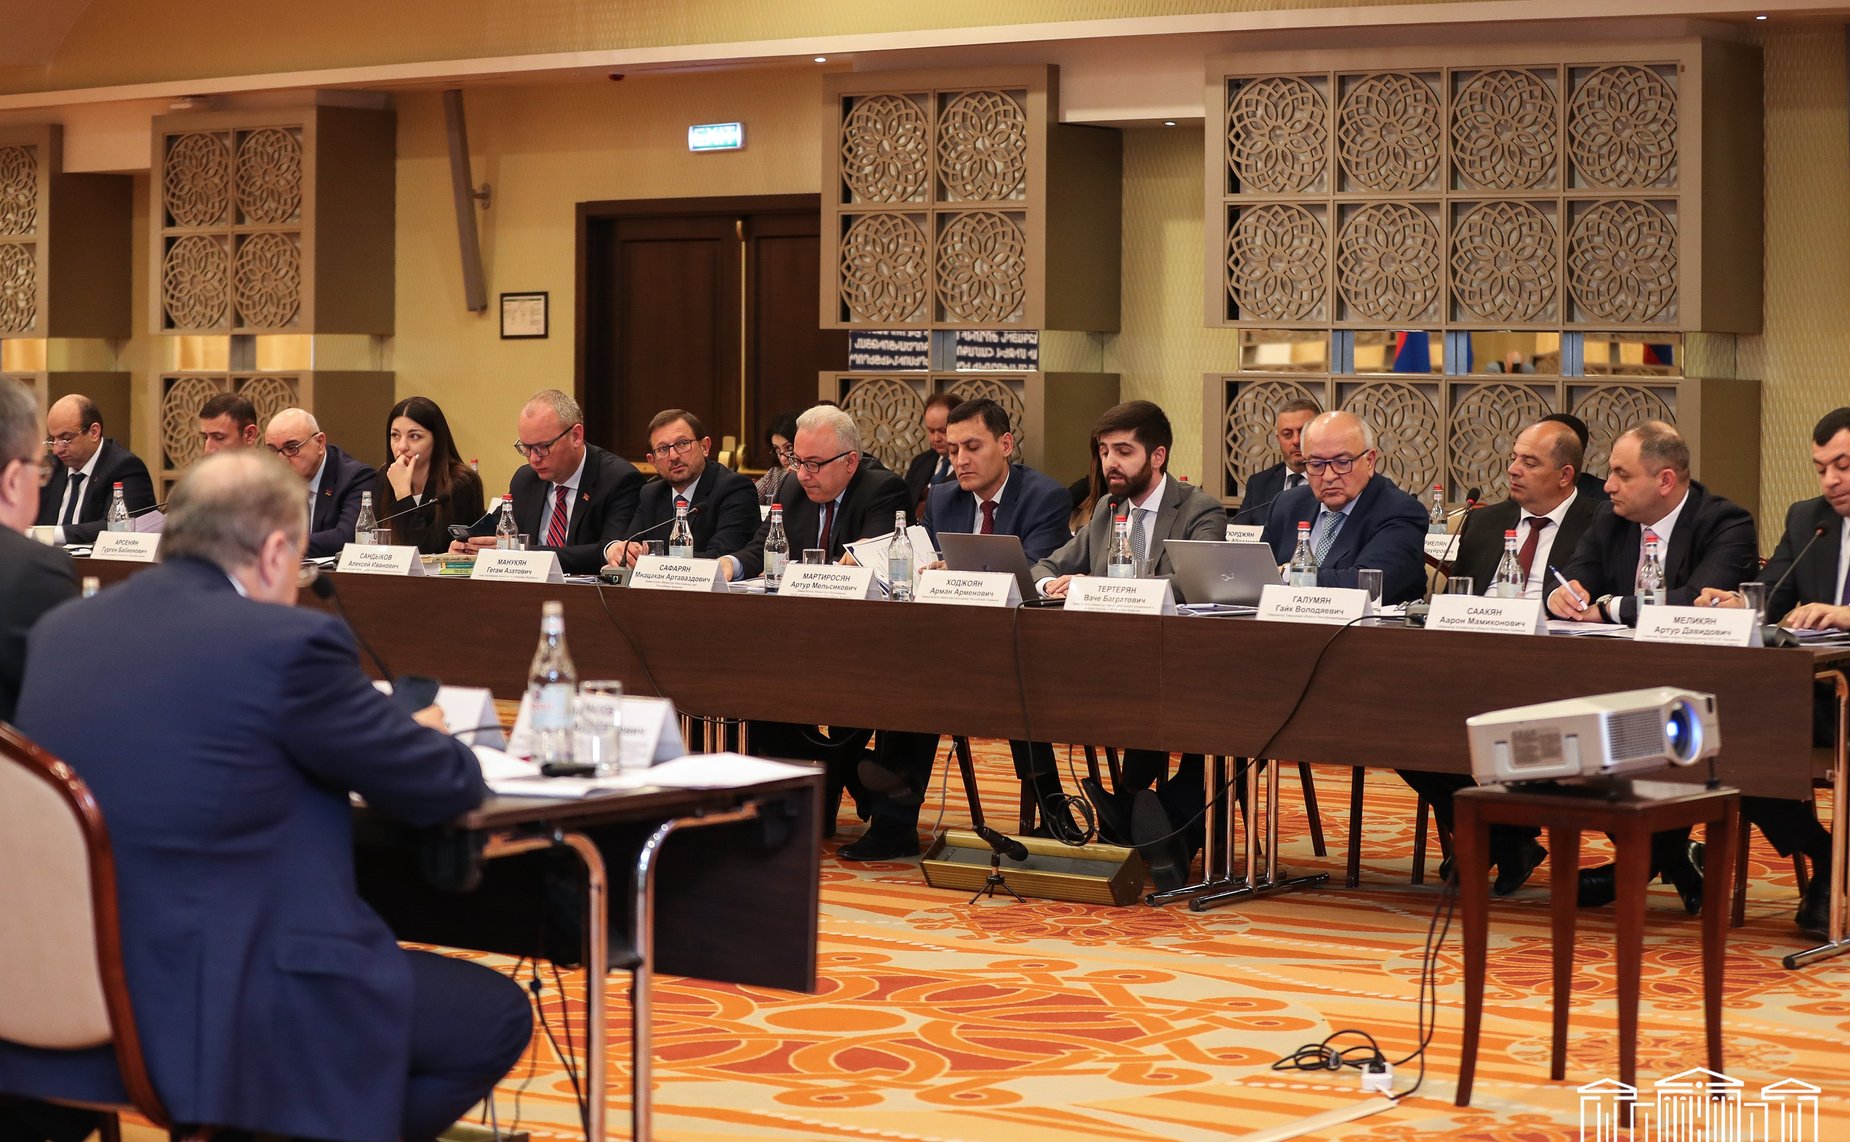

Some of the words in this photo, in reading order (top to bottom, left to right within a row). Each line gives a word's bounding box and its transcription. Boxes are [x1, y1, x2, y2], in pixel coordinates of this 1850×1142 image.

[359, 552, 393, 560] САНДЫКОВ
[486, 566, 503, 574] Гегам
[504, 567, 533, 575] Азатович
[659, 564, 691, 573] САФАРЯН
[665, 573, 711, 582] Артаваздович
[802, 573, 851, 582] МАРТИРОСЯН
[790, 581, 811, 589] Артур
[811, 582, 857, 591] Мельсикович
[946, 579, 983, 587] ХОДЖОЯН
[930, 587, 953, 595] Арман
[953, 588, 994, 597] Арменович
[1098, 585, 1137, 594] ТЕРТЕРЯН
[1102, 595, 1146, 604] Багратович
[1292, 596, 1332, 604] ГАЛУМЯН
[1295, 606, 1344, 614] Володяевич
[1467, 607, 1503, 616] СААКЯН
[1440, 616, 1465, 625] Аарон
[1467, 618, 1526, 627] Мамиконович
[1673, 616, 1717, 625] МЕЛИКЯН
[1654, 626, 1680, 635] Артур
[1682, 627, 1732, 636] Давидович
